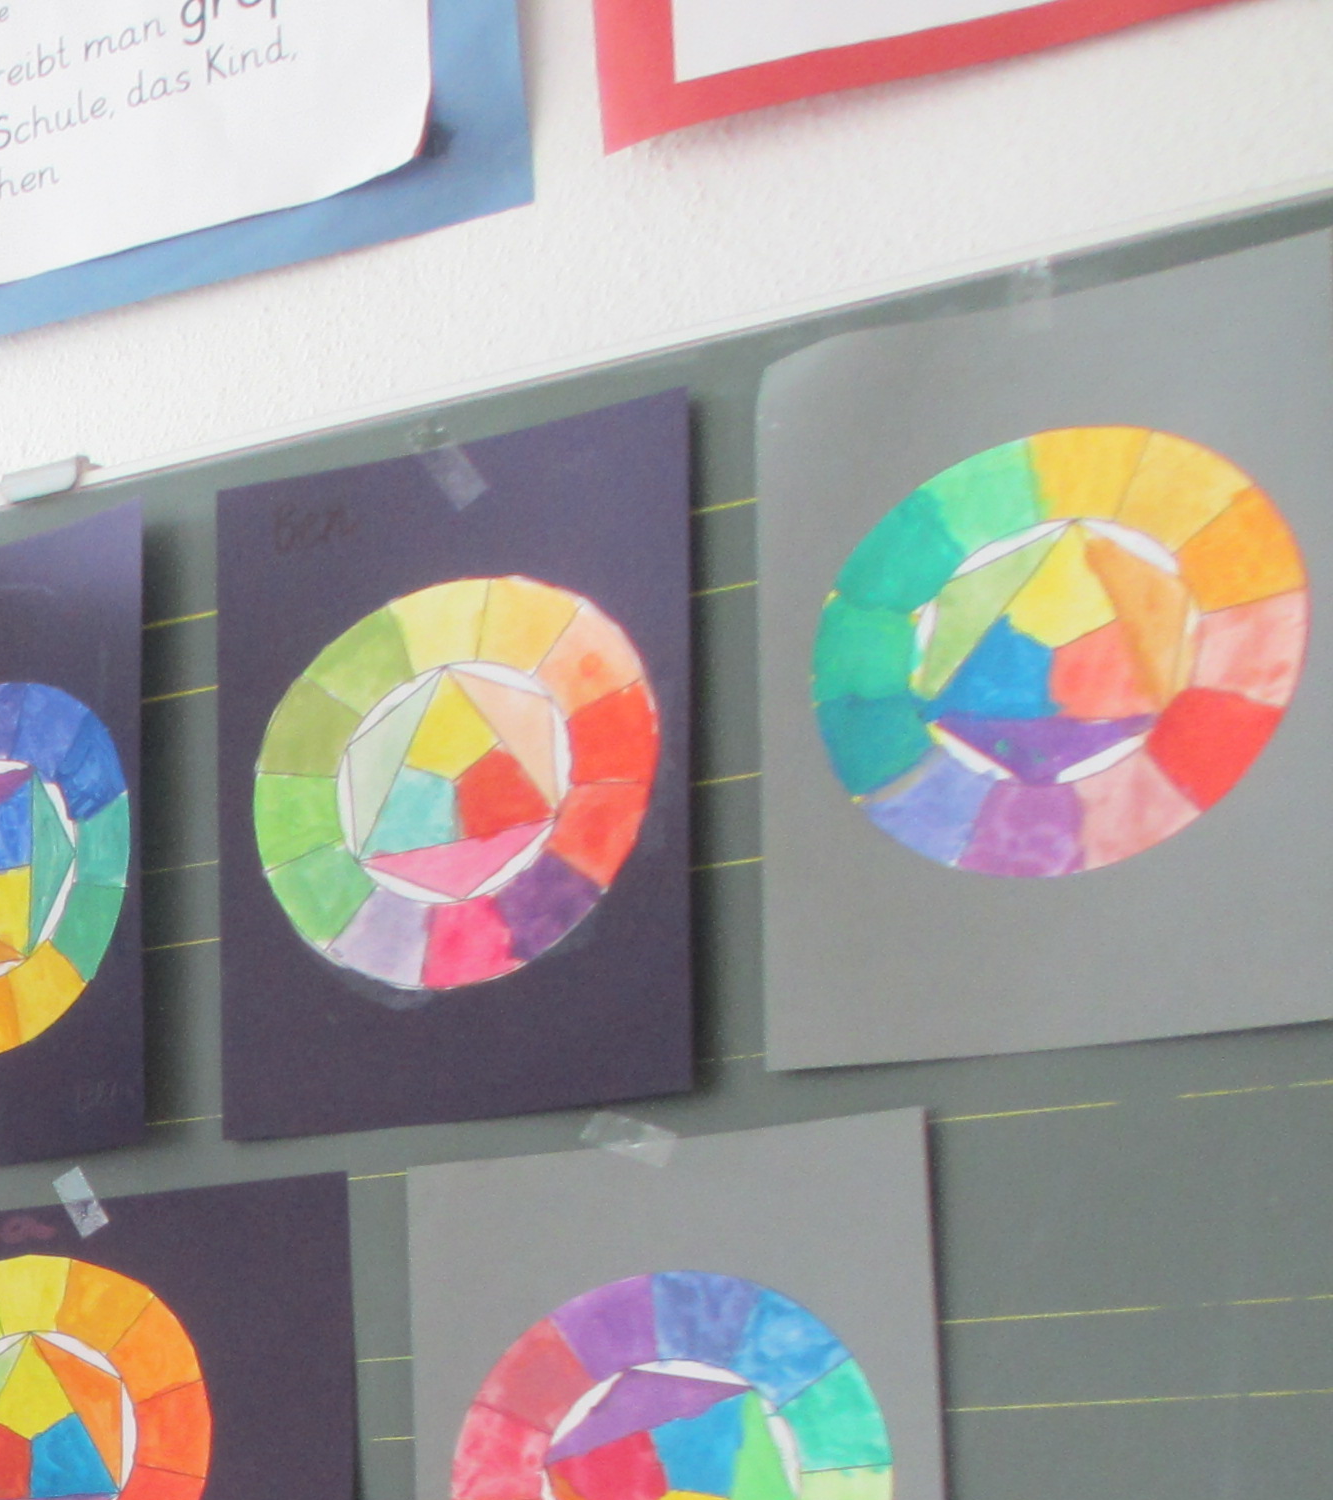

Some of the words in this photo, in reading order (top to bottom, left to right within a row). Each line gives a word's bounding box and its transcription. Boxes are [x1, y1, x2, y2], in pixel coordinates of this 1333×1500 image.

[83, 17, 166, 62] man
[126, 69, 192, 108] das
[205, 24, 298, 85] Kind,
